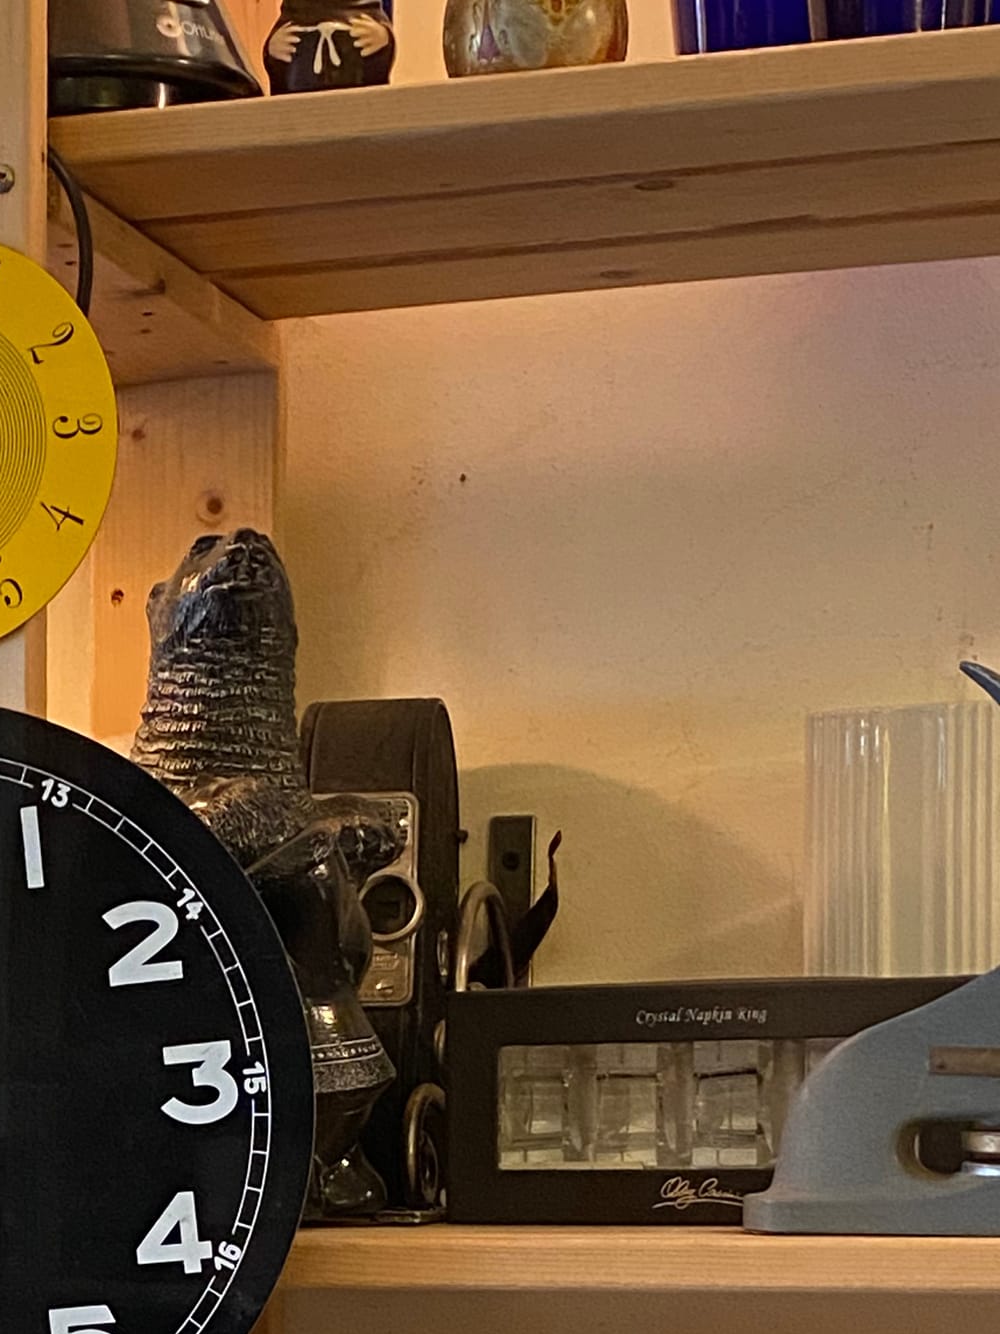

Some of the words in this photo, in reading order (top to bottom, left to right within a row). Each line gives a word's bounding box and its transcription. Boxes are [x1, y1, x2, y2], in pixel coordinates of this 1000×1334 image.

[28, 323, 74, 364] 2
[52, 414, 103, 439] 3
[40, 502, 84, 531] 4
[41, 779, 71, 807] 13
[21, 806, 44, 888] 1
[176, 889, 204, 921] 14
[102, 901, 183, 986] 2
[636, 1007, 683, 1027] Crystal
[684, 1005, 732, 1025] Napkin
[737, 1007, 767, 1024] Ring
[161, 1040, 238, 1124] 3
[243, 1061, 267, 1095] 15
[137, 1191, 213, 1274] 4
[214, 1242, 242, 1273] 16
